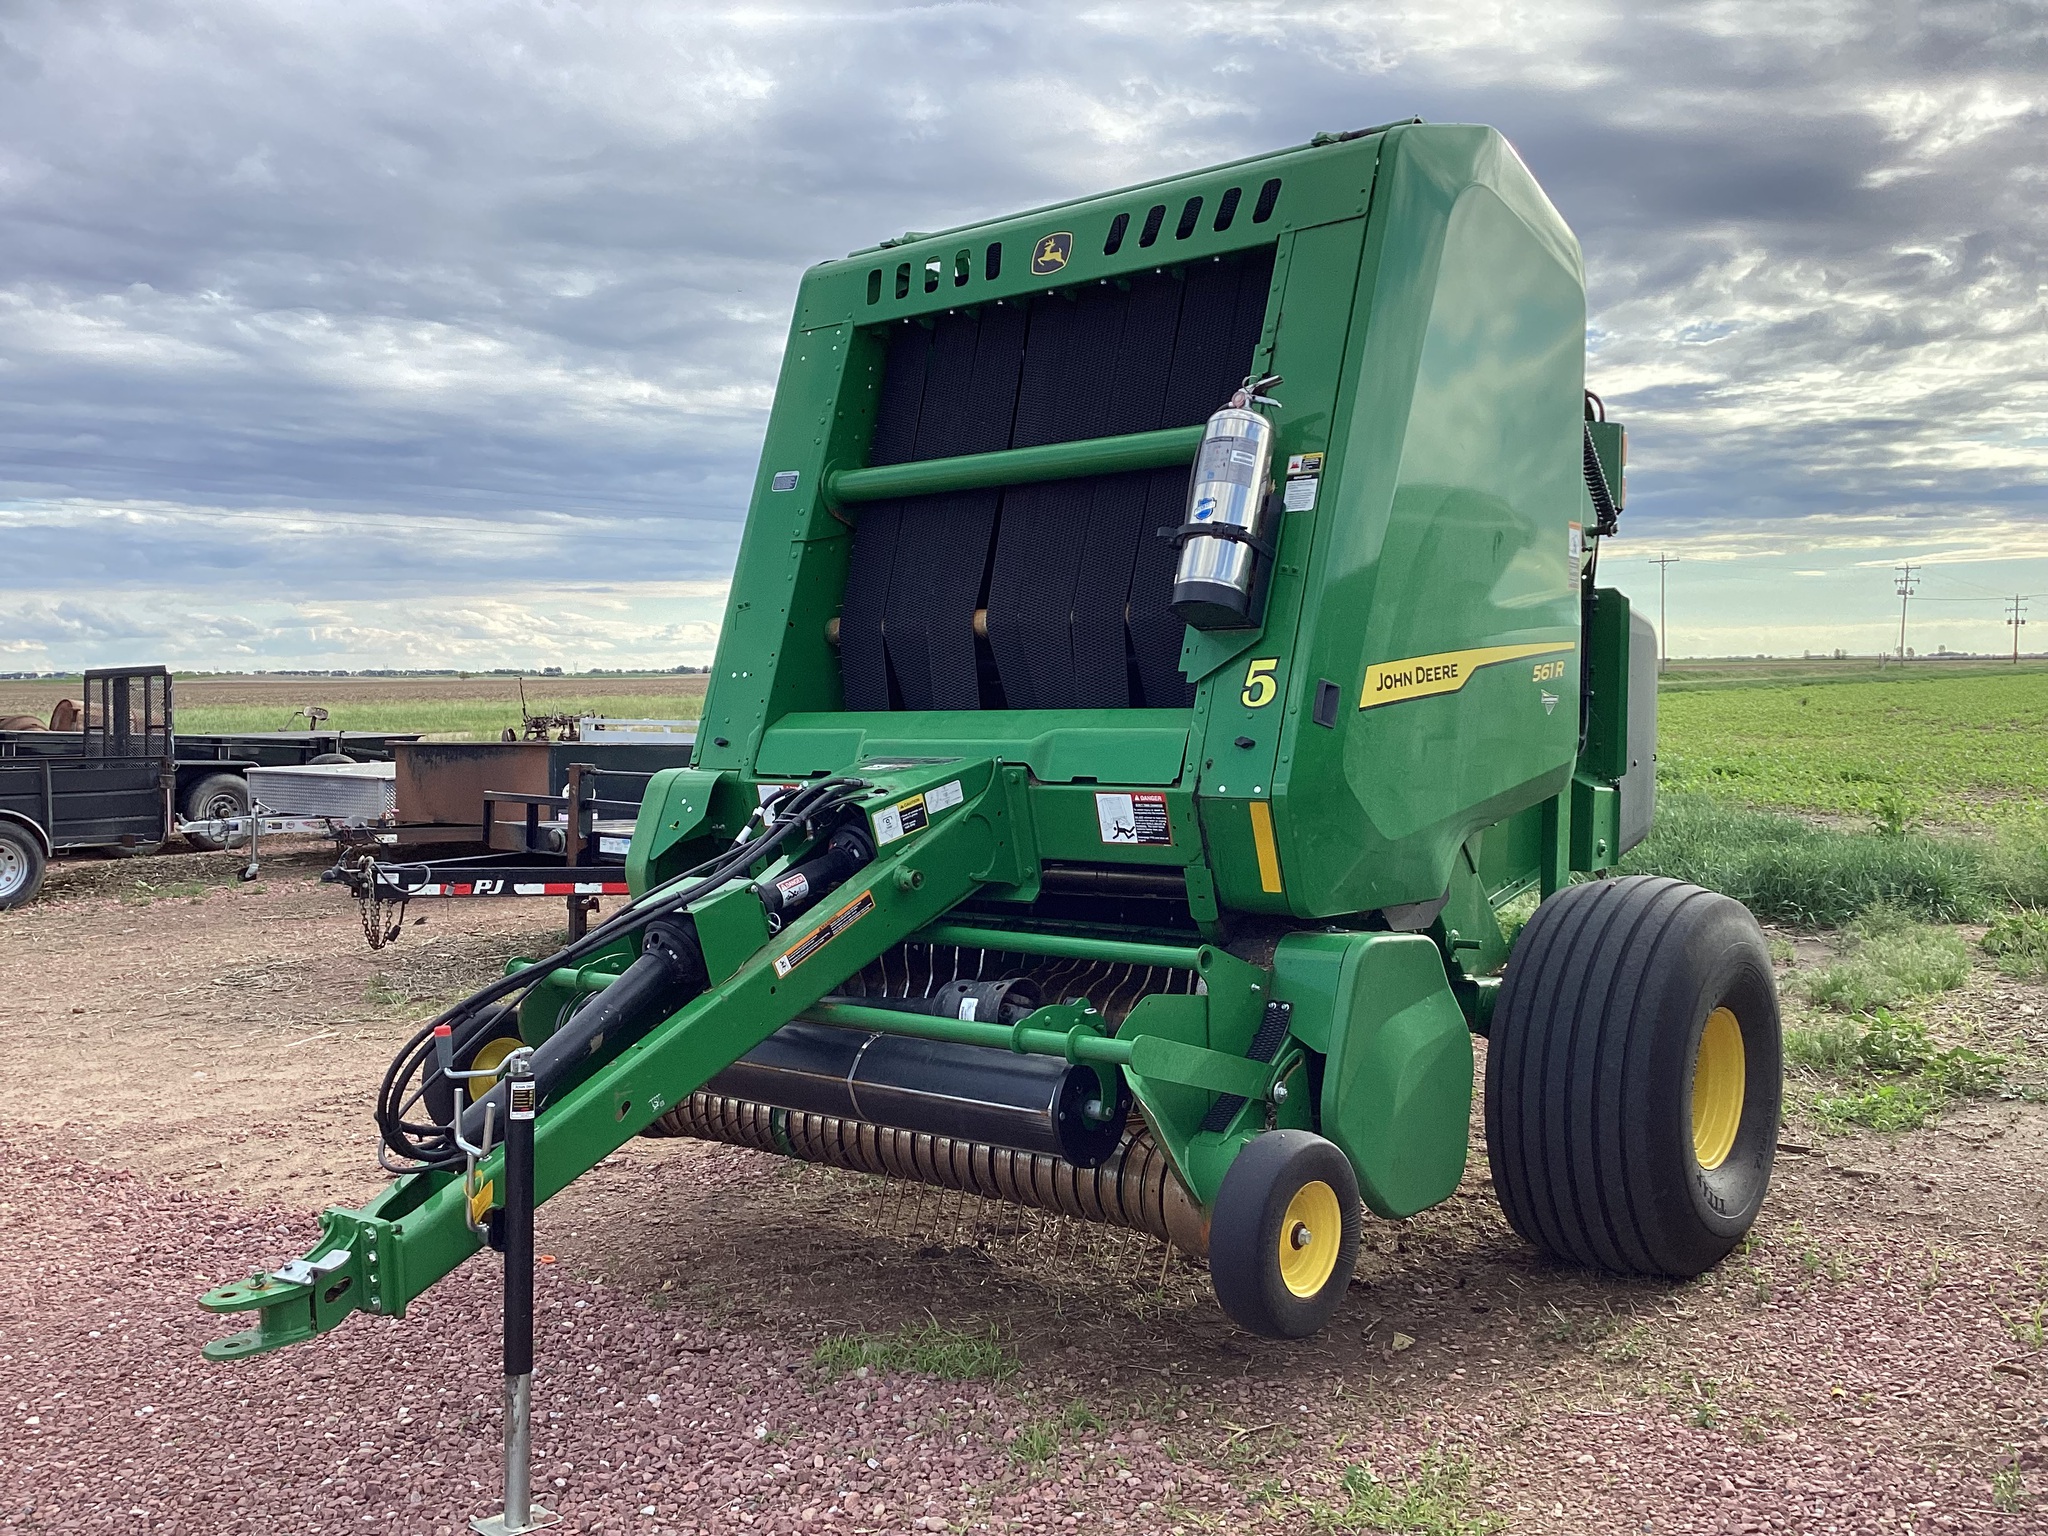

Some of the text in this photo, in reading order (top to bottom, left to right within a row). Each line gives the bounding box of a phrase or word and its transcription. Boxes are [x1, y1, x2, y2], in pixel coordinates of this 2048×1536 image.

[1241, 657, 1279, 708] 5
[1376, 663, 1459, 692] JOHN DEERE
[472, 879, 504, 894] PJ
